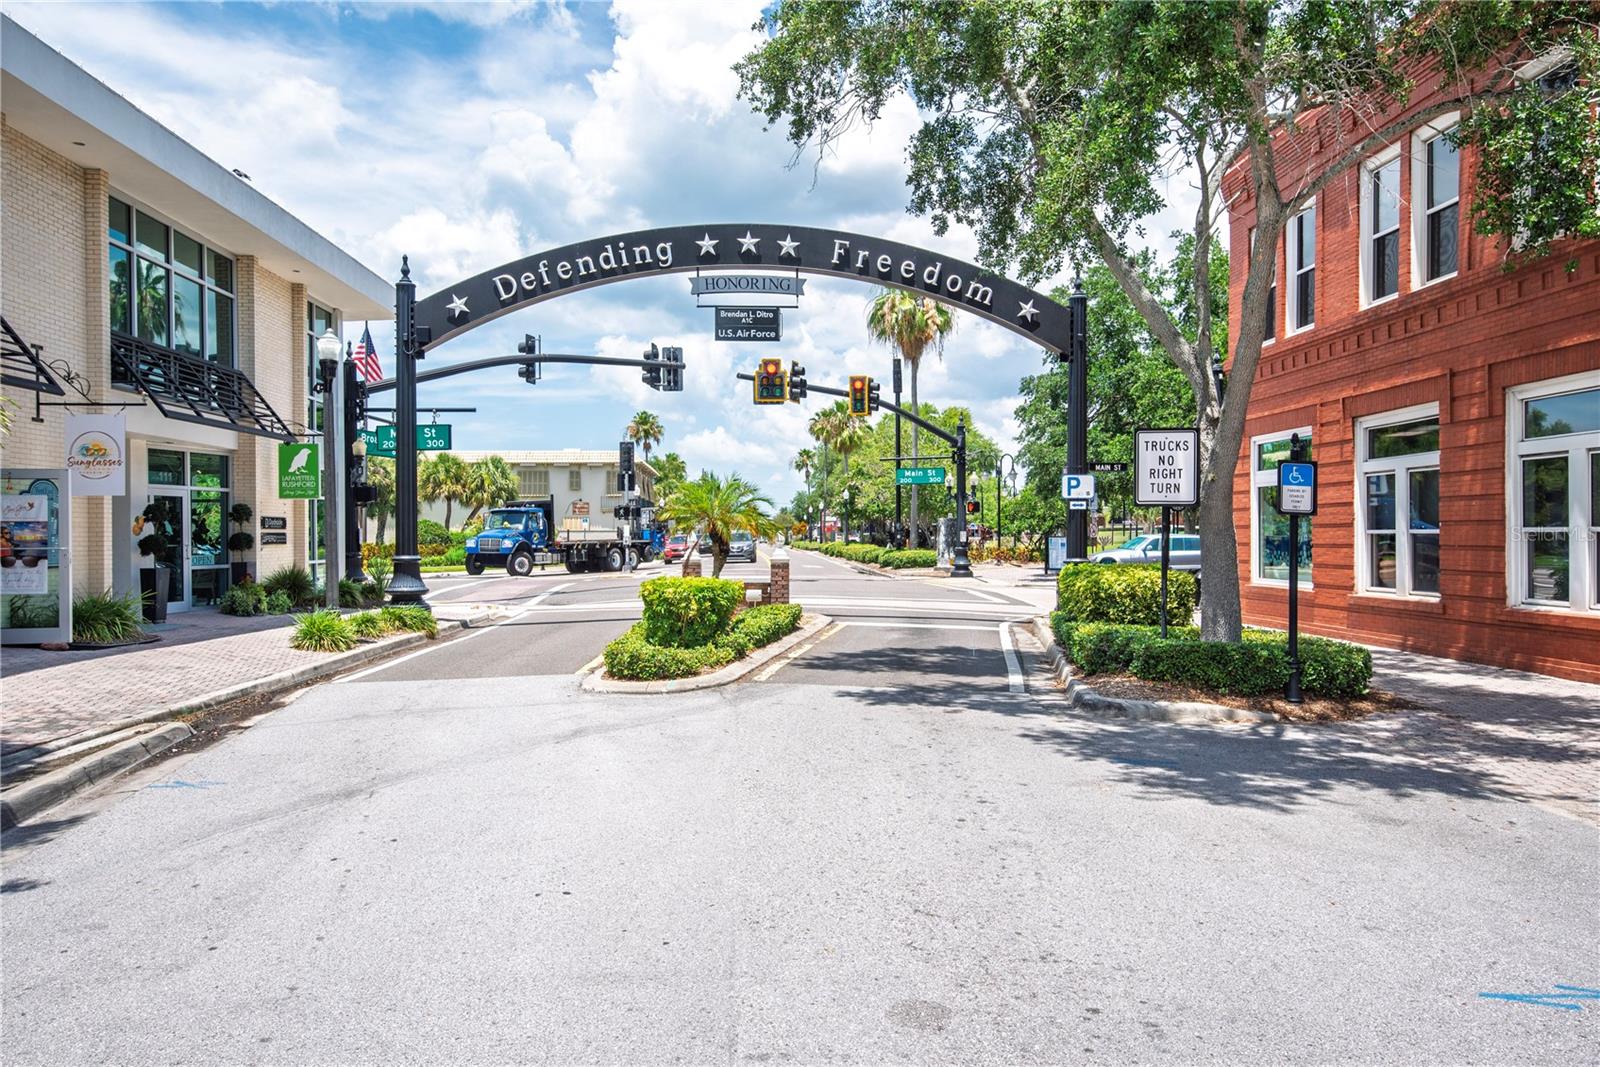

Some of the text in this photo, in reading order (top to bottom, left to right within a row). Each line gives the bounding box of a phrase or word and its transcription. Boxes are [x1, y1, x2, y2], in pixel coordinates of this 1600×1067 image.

[492, 239, 993, 306] Defending Freedom
[705, 277, 791, 291] HONORING
[720, 310, 748, 318] Brendan
[756, 310, 774, 318] Ditro
[718, 329, 735, 338] U.S.
[750, 329, 776, 338] Force
[424, 428, 436, 437] St
[1144, 440, 1189, 451] TRUCKS
[67, 456, 123, 468] Sunglasses
[1158, 455, 1175, 466] NO
[1149, 468, 1183, 479] RIGHT
[1067, 477, 1081, 497] P
[1150, 483, 1180, 493] TURN
